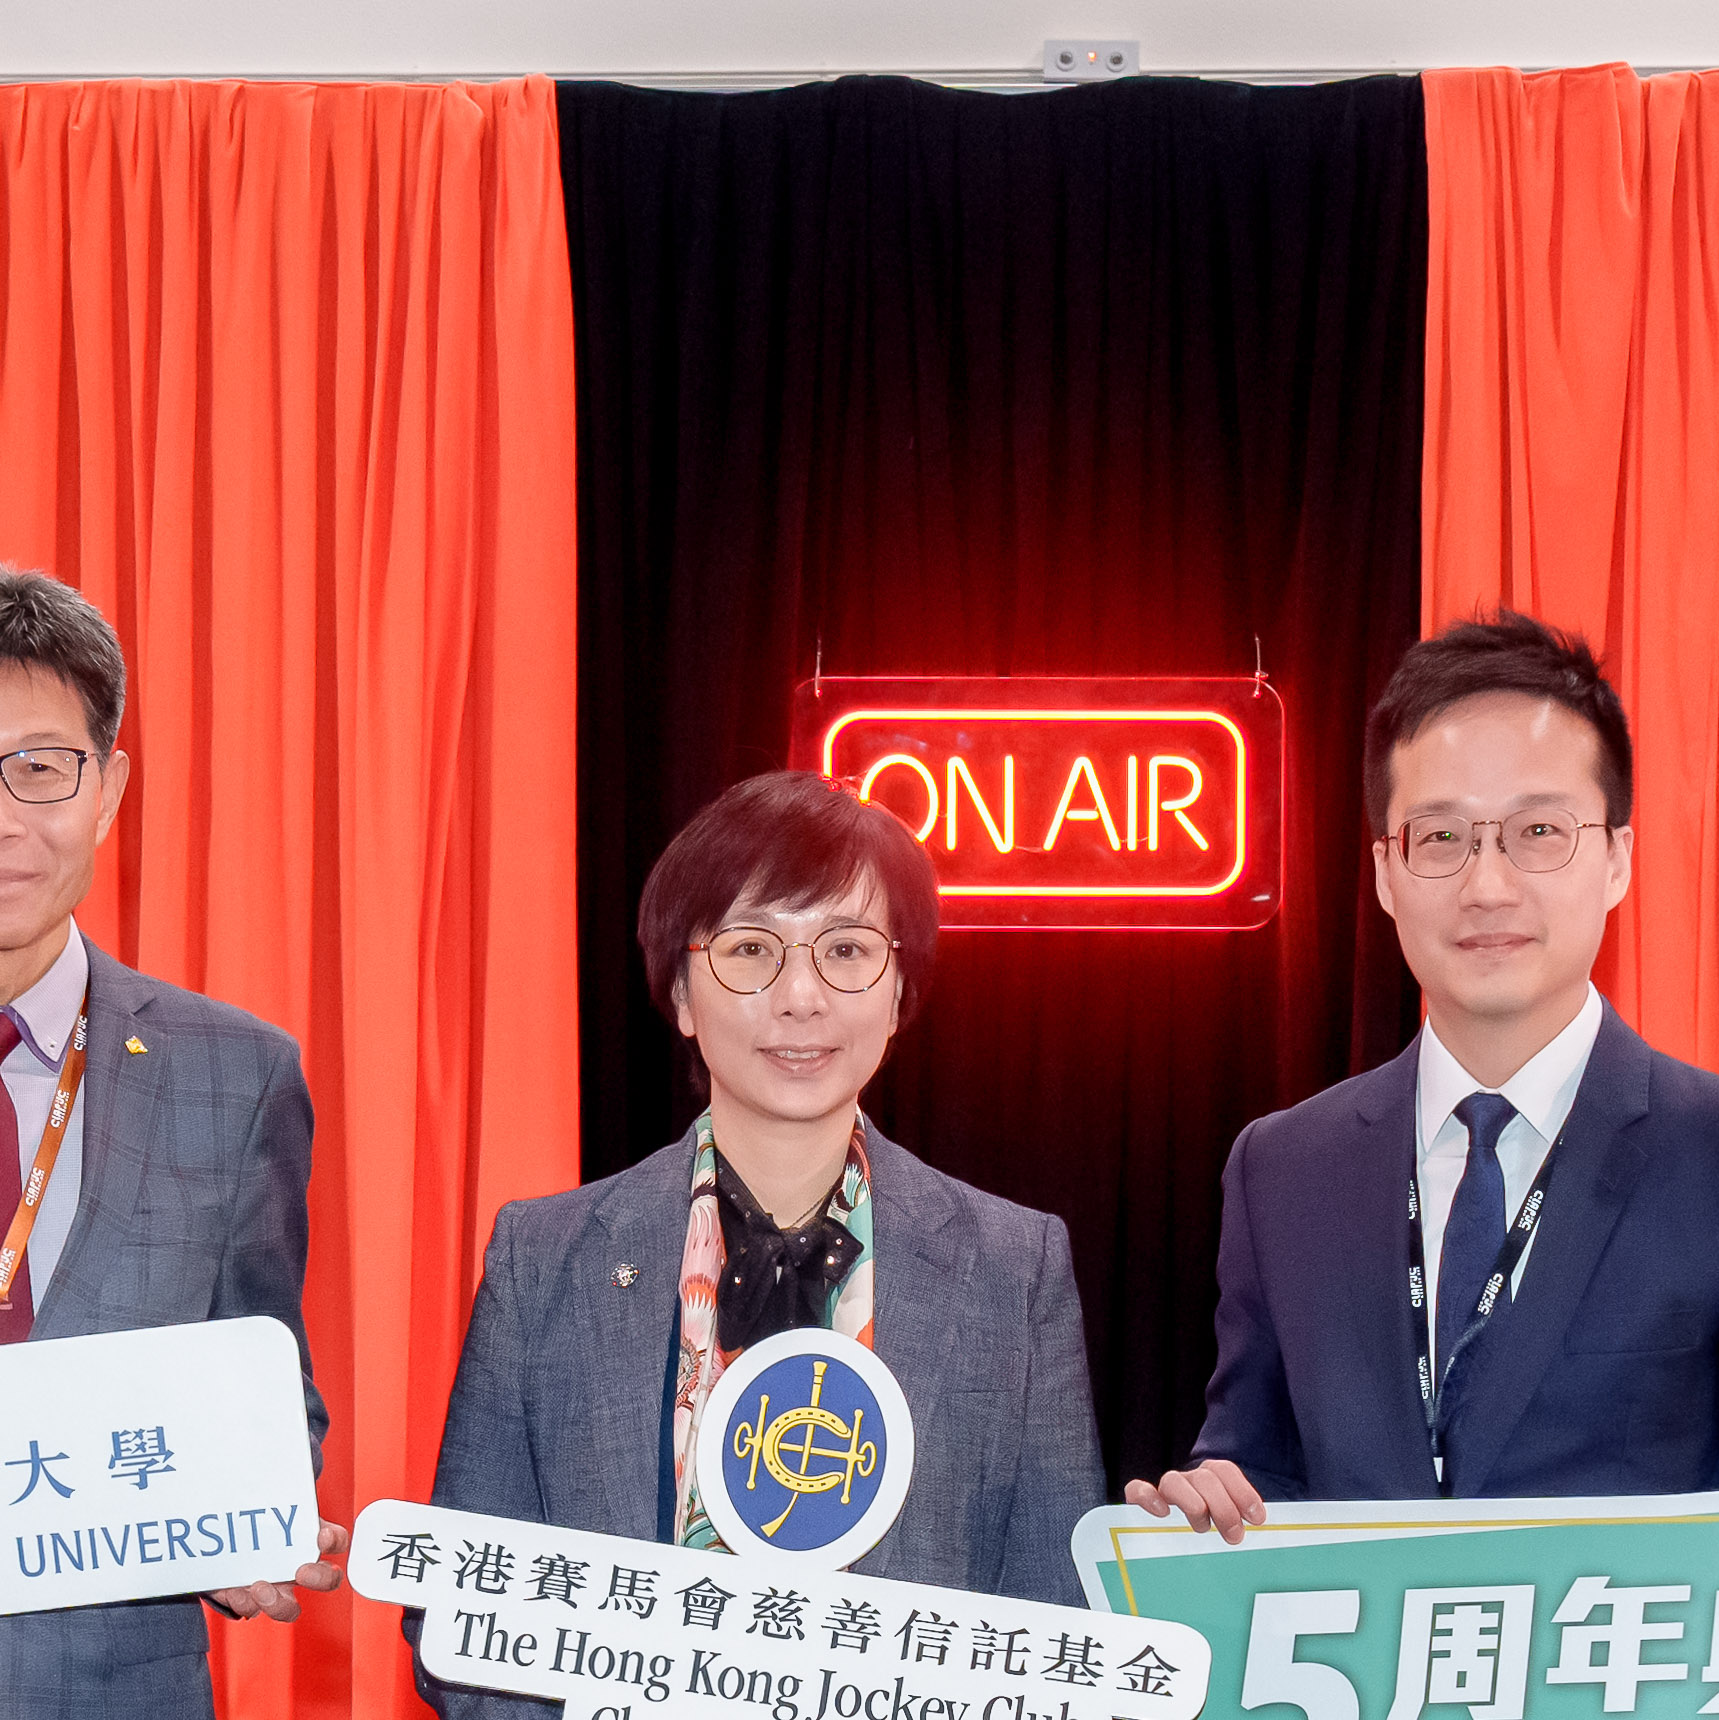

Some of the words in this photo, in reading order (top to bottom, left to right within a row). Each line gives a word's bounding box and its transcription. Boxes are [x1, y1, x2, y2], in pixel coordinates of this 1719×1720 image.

[859, 752, 1015, 854] ON
[1043, 752, 1210, 853] AIR
[16, 1504, 298, 1578] UNIVERSITY
[377, 1532, 1182, 1698] 香港賽馬會慈善信託基金
[454, 1608, 537, 1667] The
[550, 1627, 674, 1703] Hong
